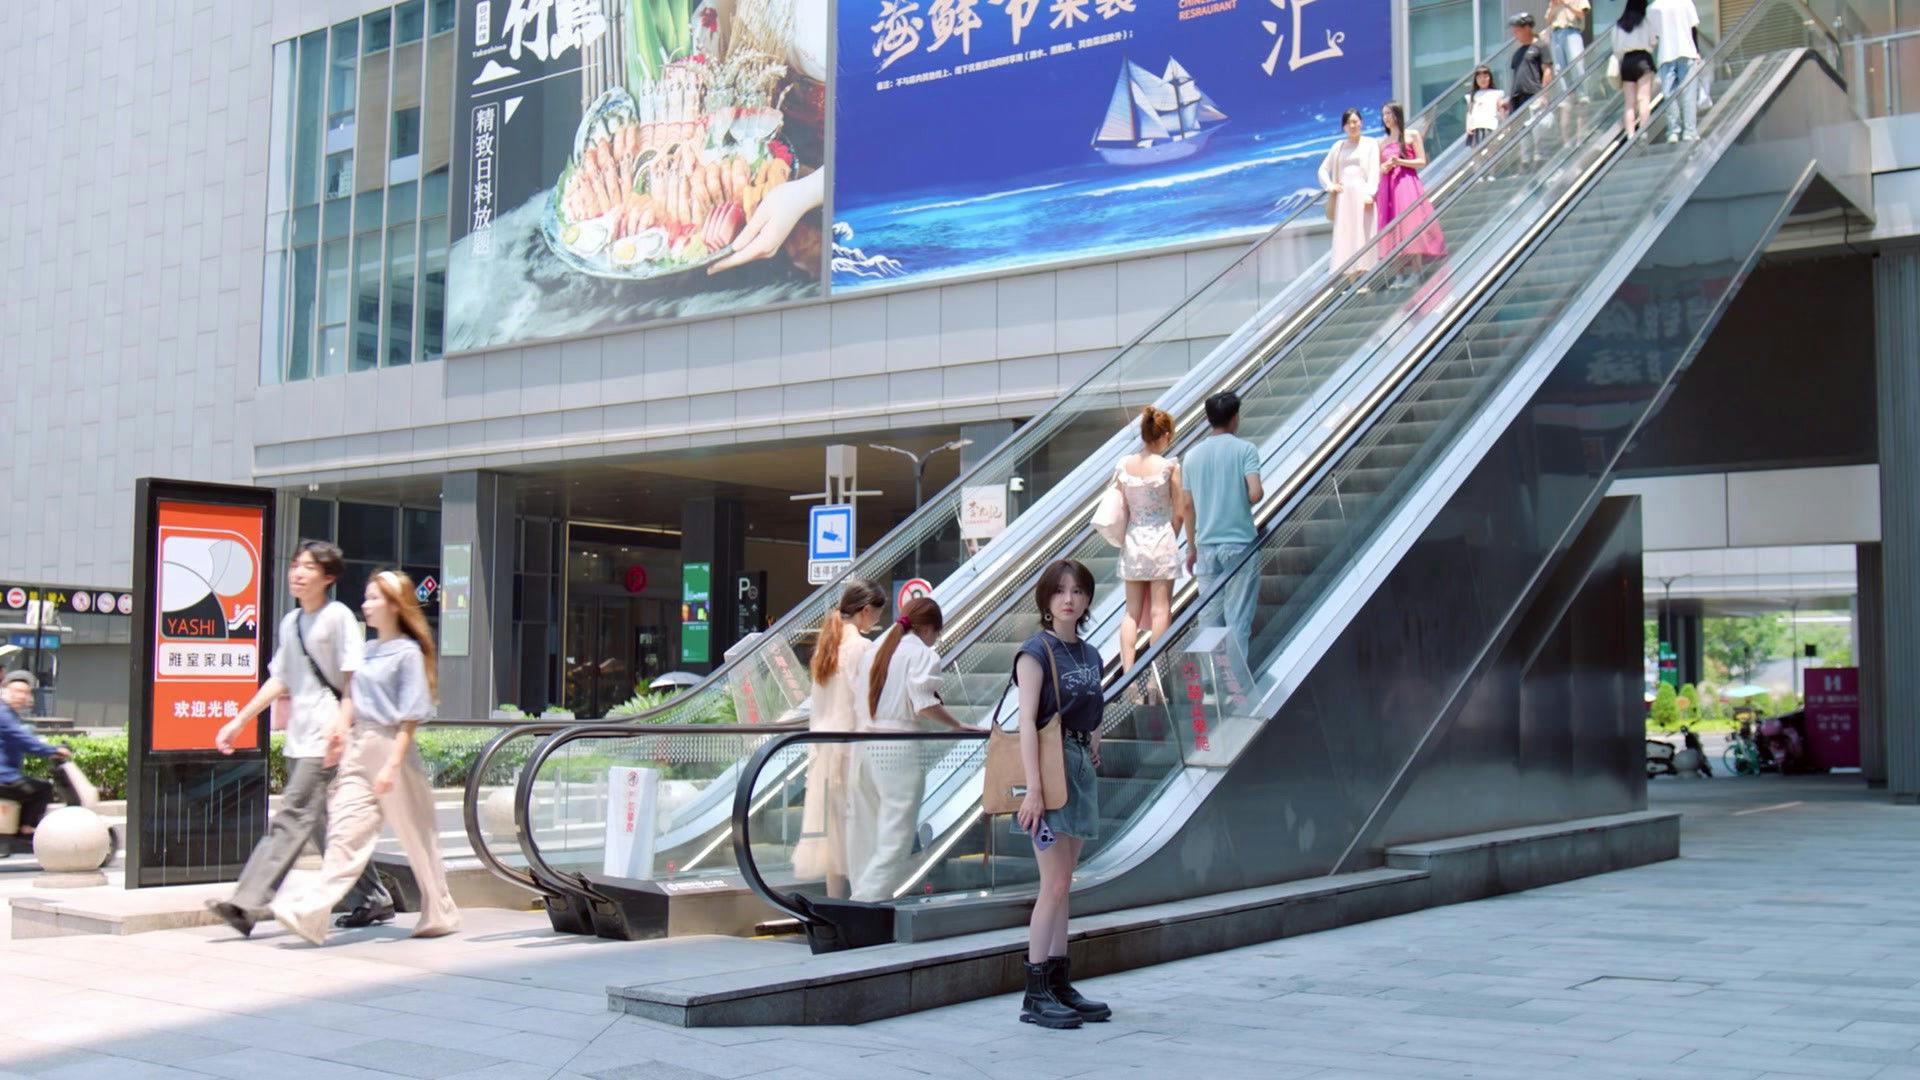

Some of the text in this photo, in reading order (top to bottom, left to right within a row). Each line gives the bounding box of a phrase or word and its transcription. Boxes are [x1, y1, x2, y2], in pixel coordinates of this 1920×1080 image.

[739, 578, 751, 600] P
[167, 618, 216, 637] YASHI
[168, 652, 250, 667] 雅室家具城
[174, 699, 239, 718] 欢迎光临
